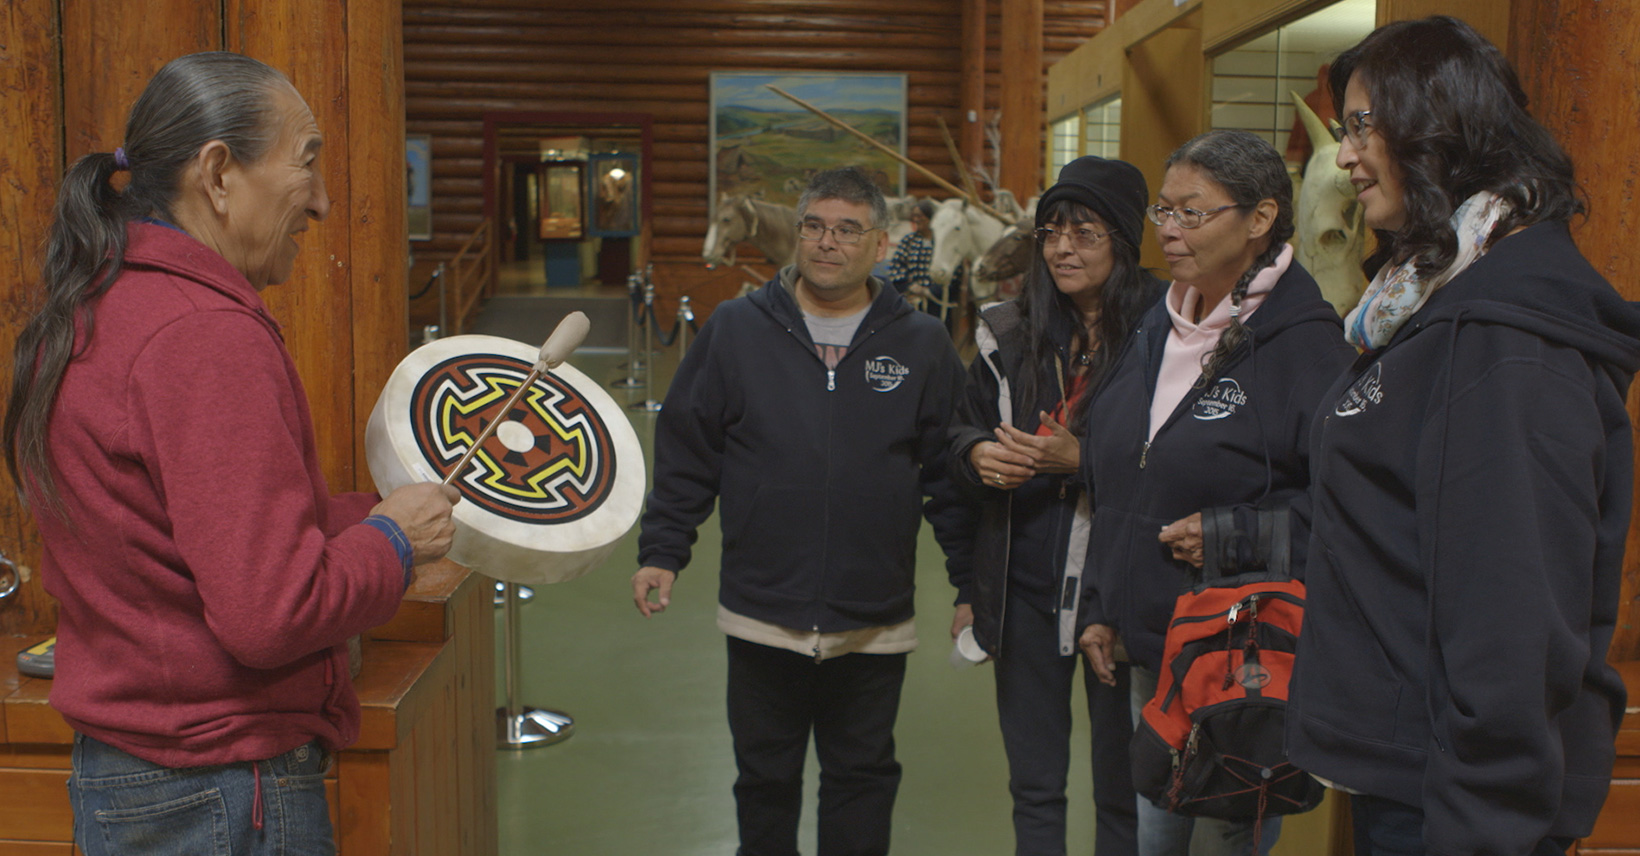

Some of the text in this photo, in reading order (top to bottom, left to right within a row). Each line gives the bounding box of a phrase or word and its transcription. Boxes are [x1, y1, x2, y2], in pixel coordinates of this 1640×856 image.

[865, 360, 910, 375] MJ's Kids
[1222, 387, 1248, 406] Kids
[1361, 375, 1383, 404] Kids
[1197, 397, 1228, 410] September
